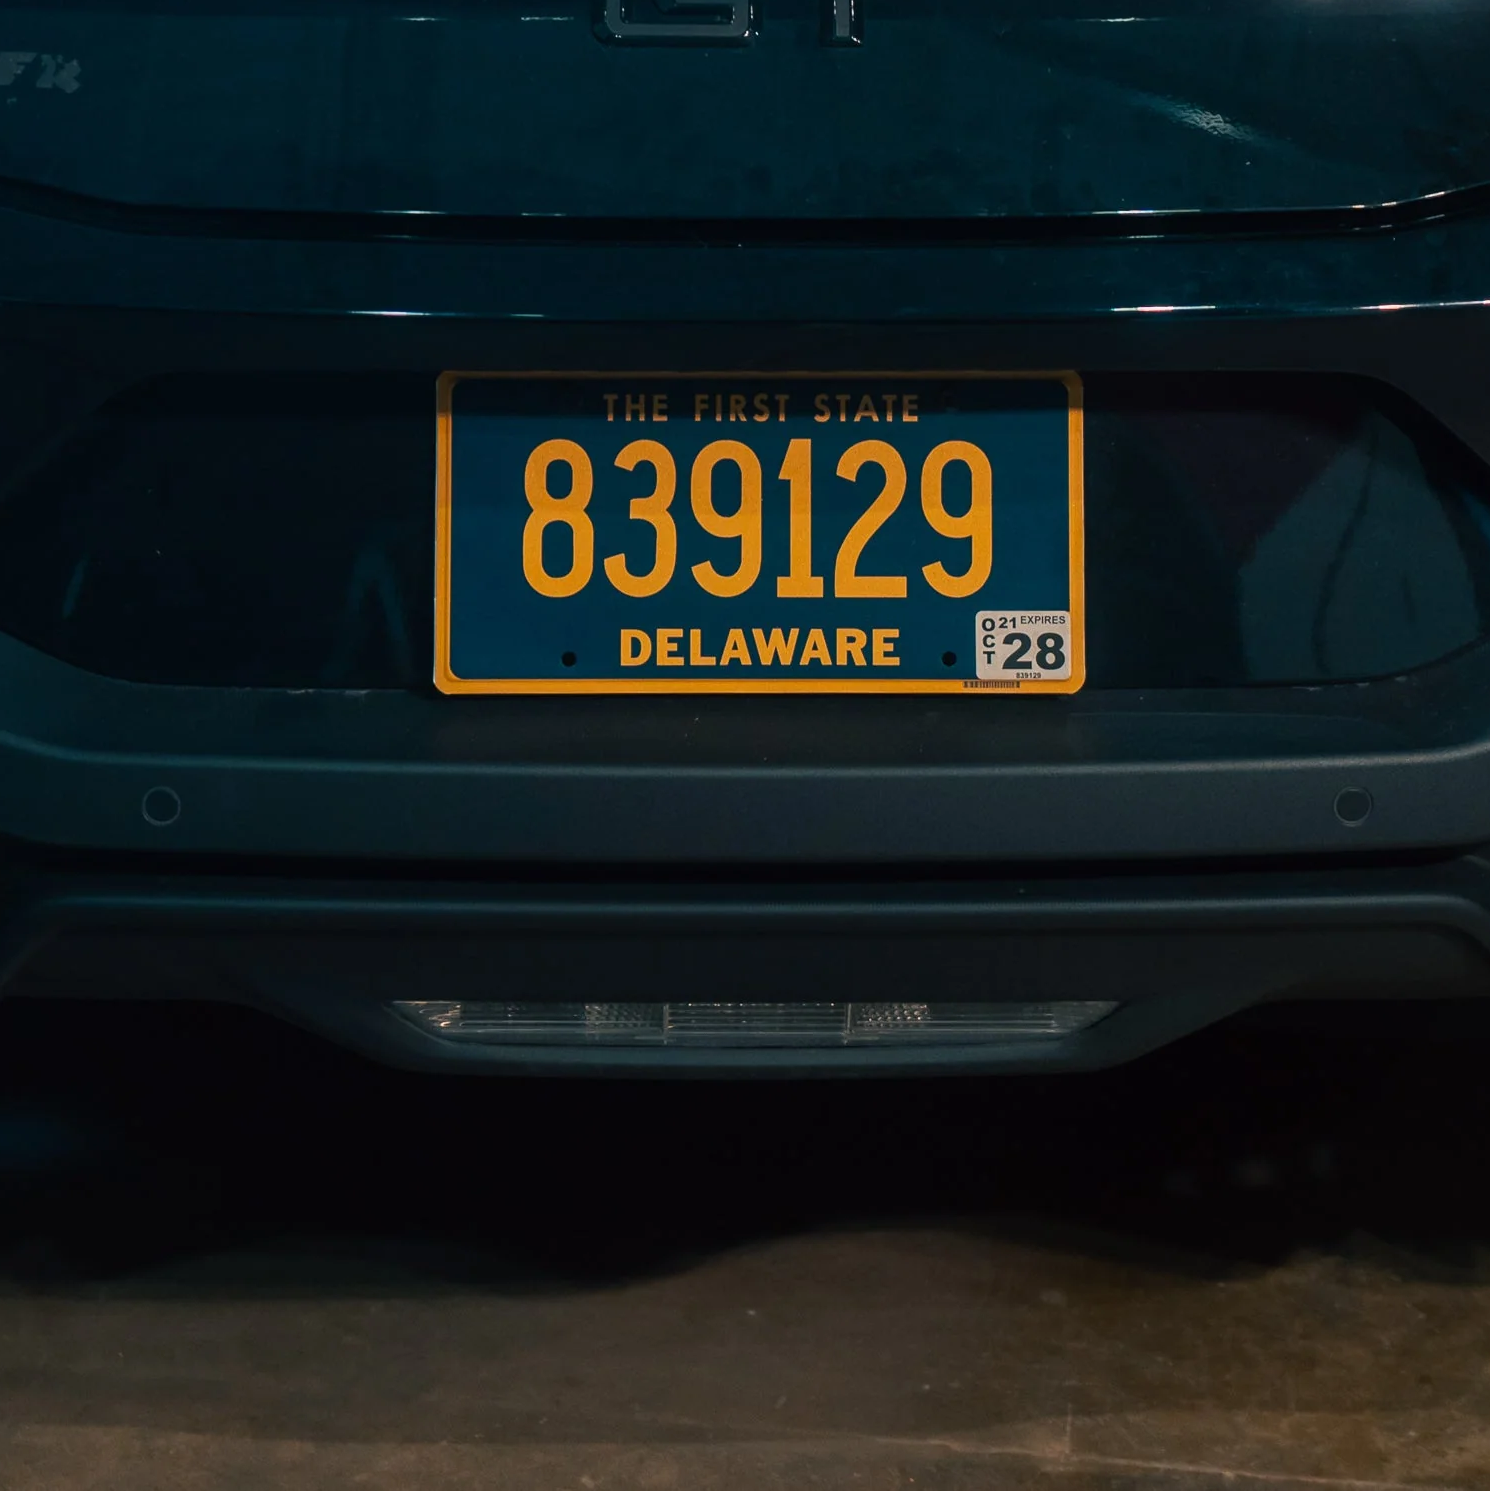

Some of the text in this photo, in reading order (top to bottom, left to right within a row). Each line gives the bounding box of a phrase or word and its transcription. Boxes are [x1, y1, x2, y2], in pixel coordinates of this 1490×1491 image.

[603, 394, 919, 422] THE FIRST STATE
[522, 438, 993, 598] 839129
[981, 617, 996, 665] OCT
[998, 615, 1066, 629] 21 EXPIRES
[619, 628, 901, 667] DELAWARE
[1002, 632, 1066, 670] 28
